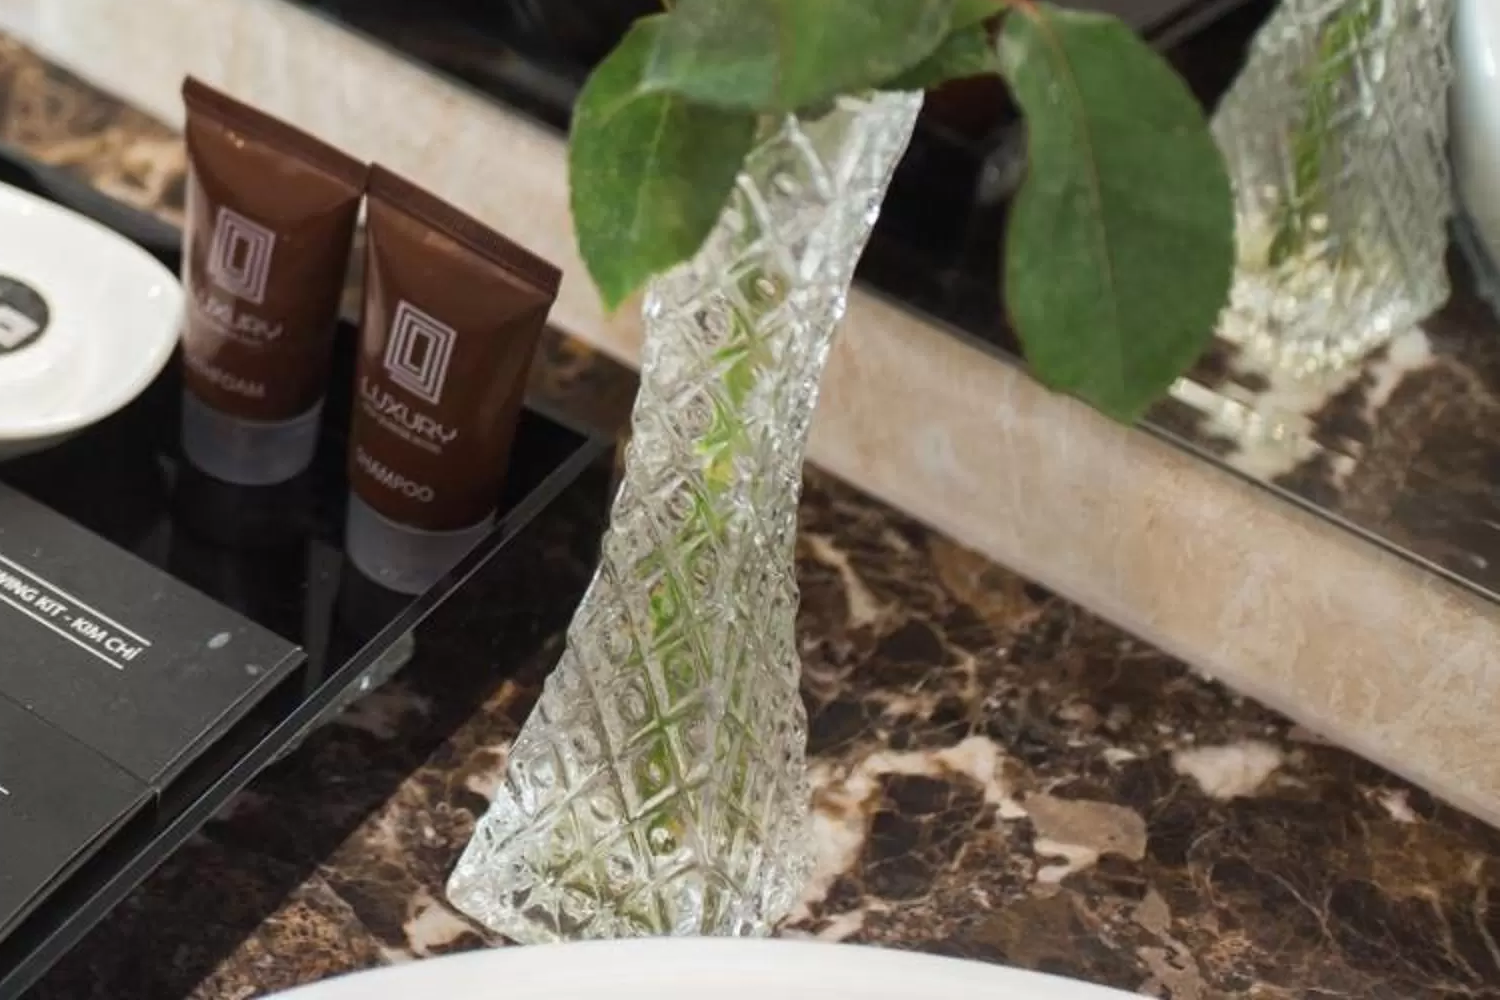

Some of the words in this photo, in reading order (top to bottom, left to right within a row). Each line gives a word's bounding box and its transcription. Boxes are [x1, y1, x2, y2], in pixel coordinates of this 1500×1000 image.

[359, 375, 459, 444] LUXURY
[33, 596, 69, 617] KIT
[70, 617, 108, 643] KIM
